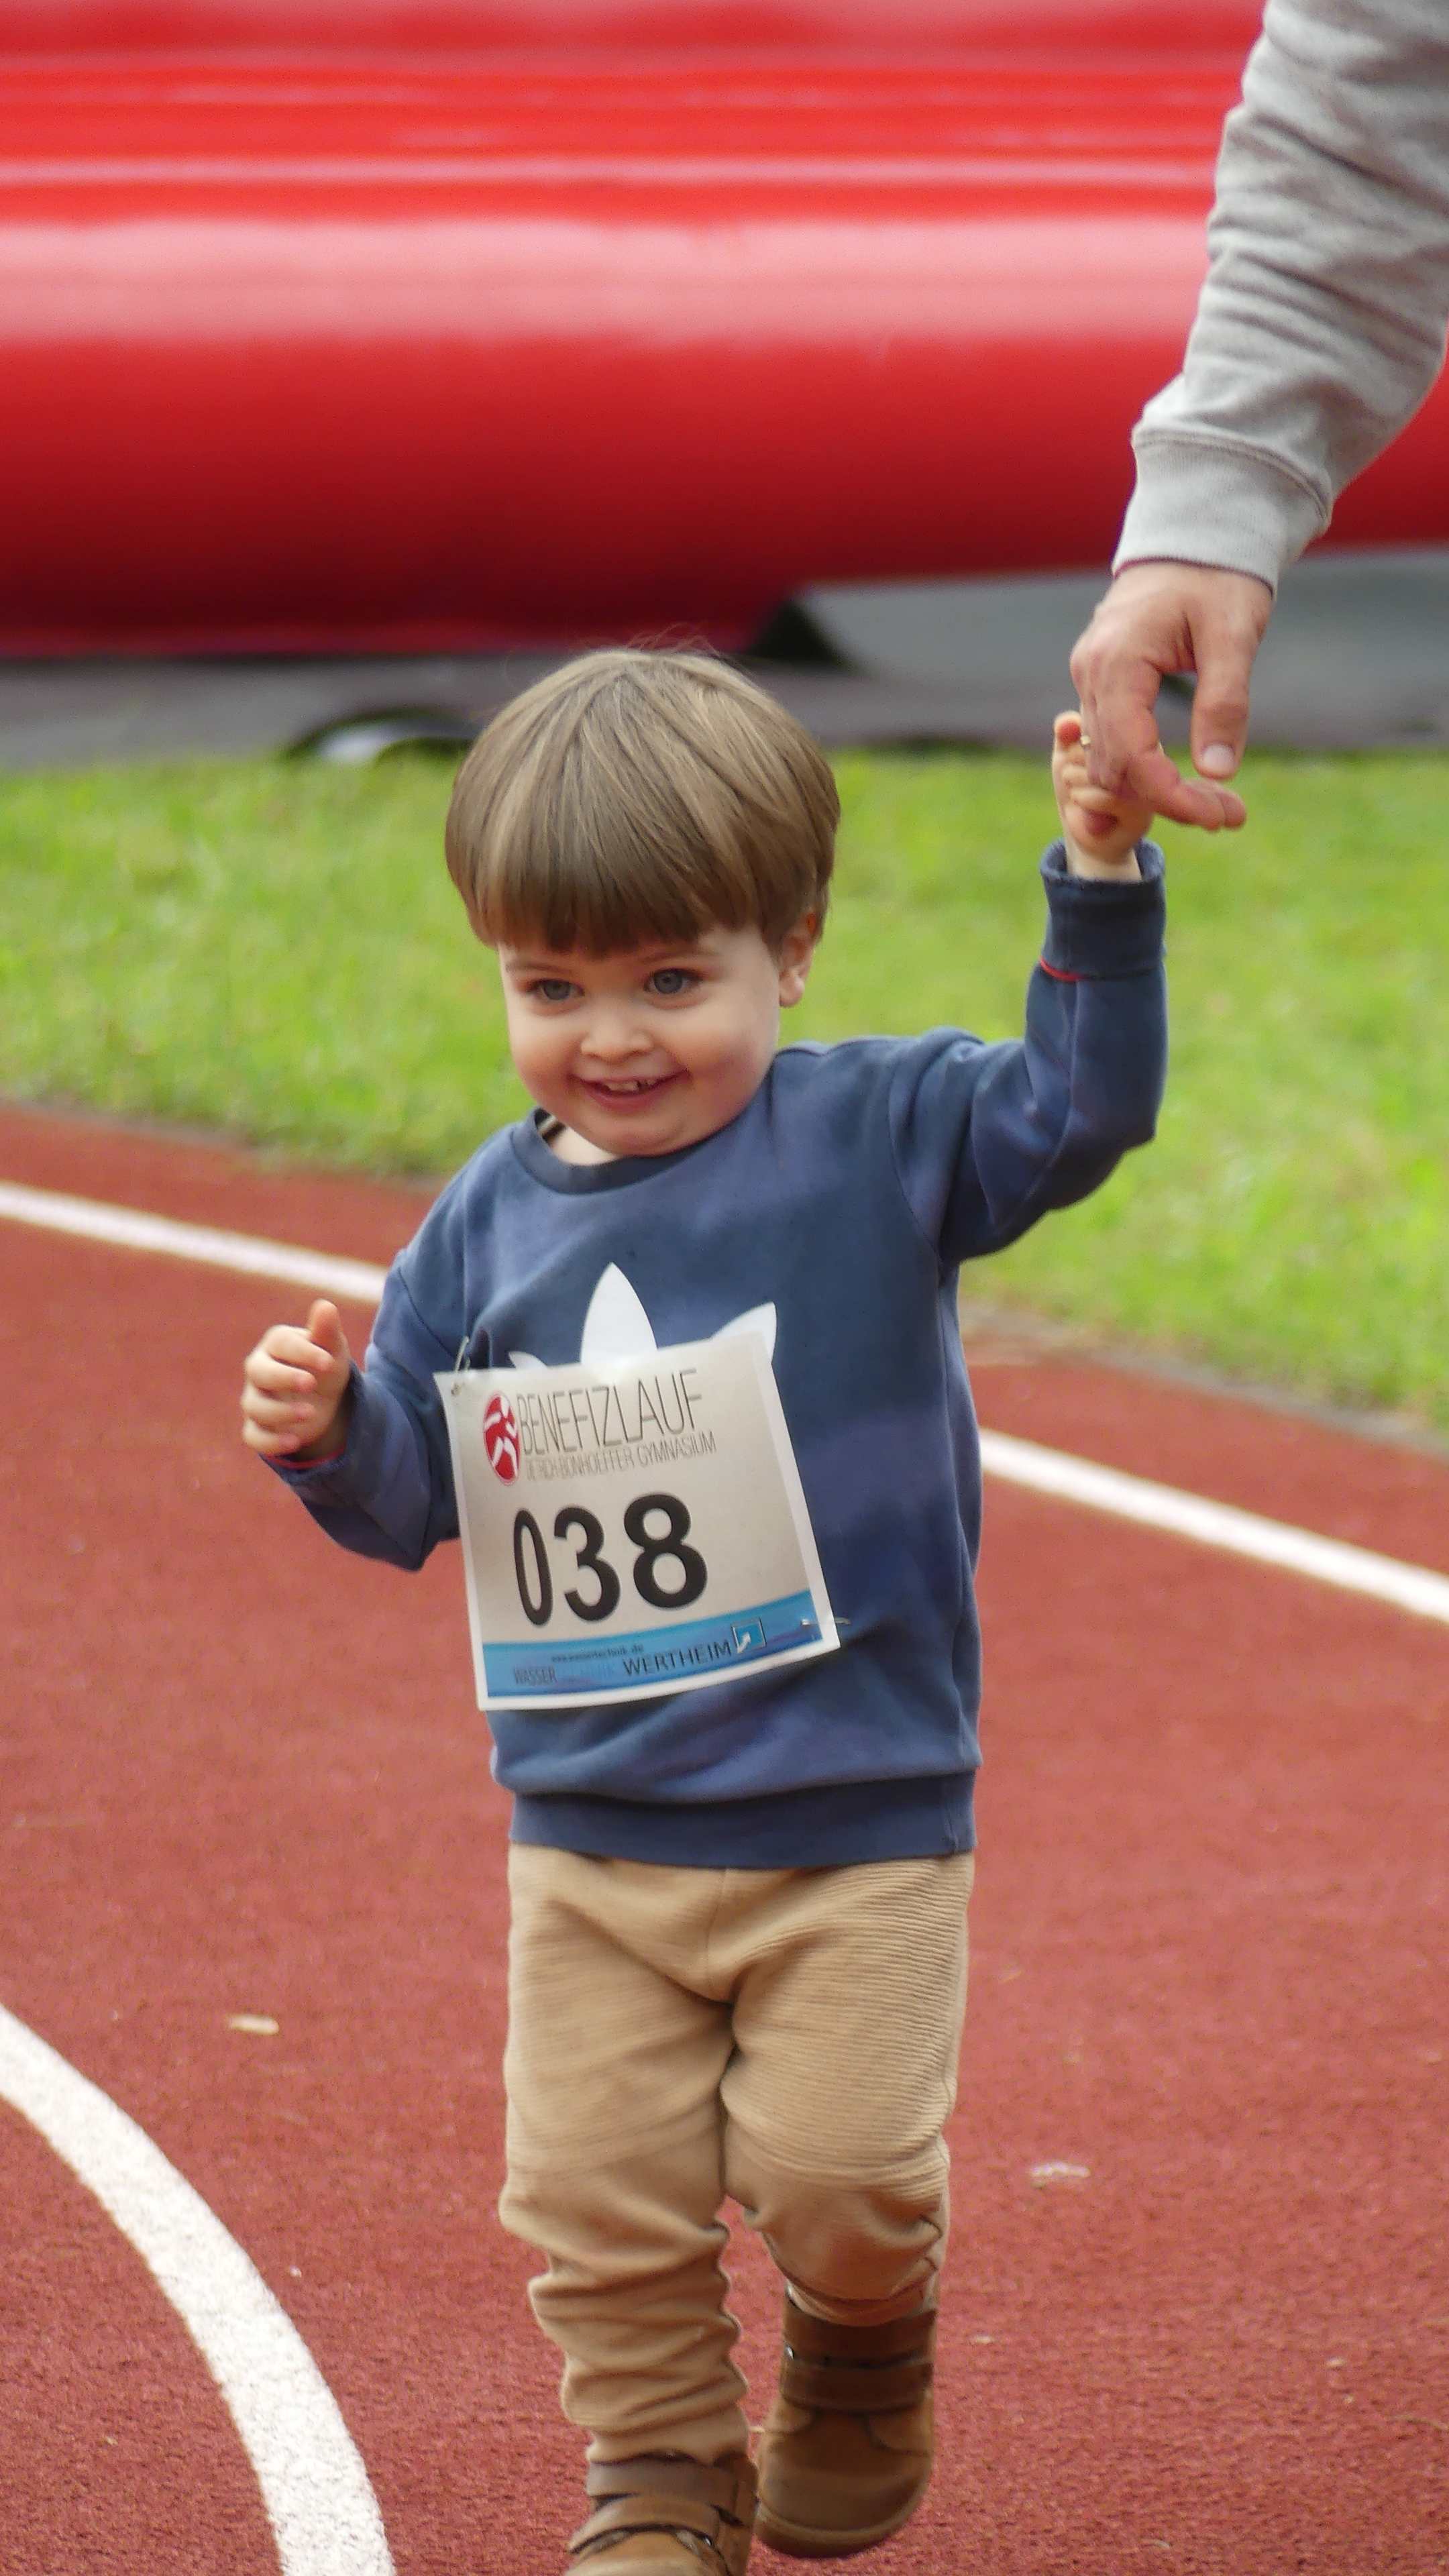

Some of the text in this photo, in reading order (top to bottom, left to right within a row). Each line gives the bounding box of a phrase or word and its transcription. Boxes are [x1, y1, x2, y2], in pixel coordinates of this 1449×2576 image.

[517, 1368, 702, 1455] BENEFIZLAUF
[637, 1430, 717, 1468] GYMNASIUM
[513, 1491, 708, 1627] 038
[623, 1639, 733, 1676] WERTHEIM
